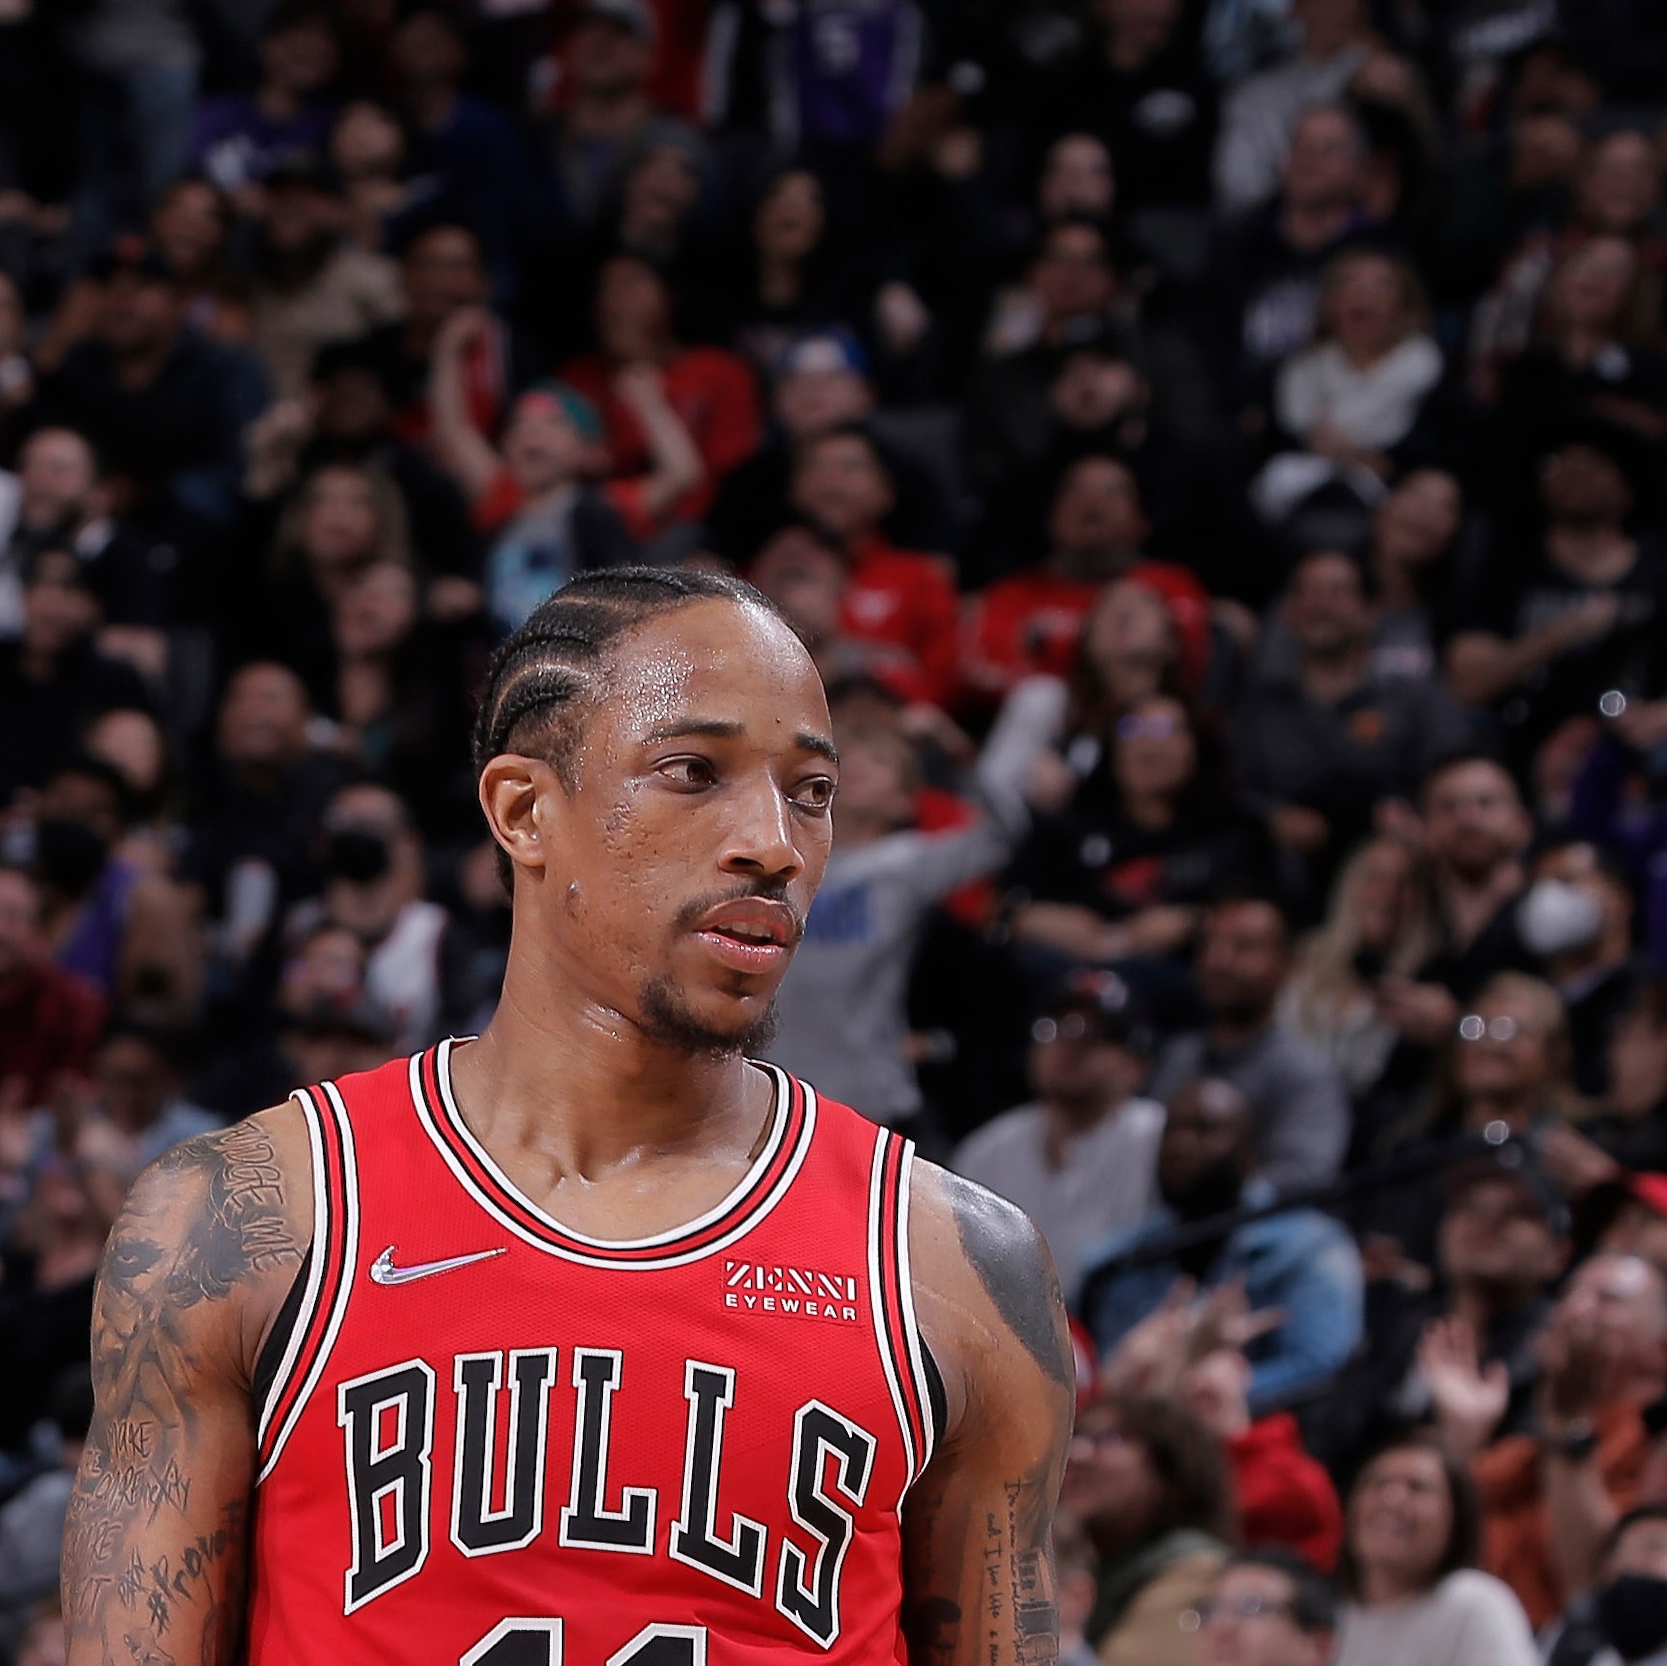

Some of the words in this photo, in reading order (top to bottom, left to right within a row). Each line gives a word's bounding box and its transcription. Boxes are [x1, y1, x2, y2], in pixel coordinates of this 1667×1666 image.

[724, 1260, 857, 1301] ZENNI
[724, 1294, 859, 1322] EYEWEAR
[337, 1346, 877, 1650] BULLS
